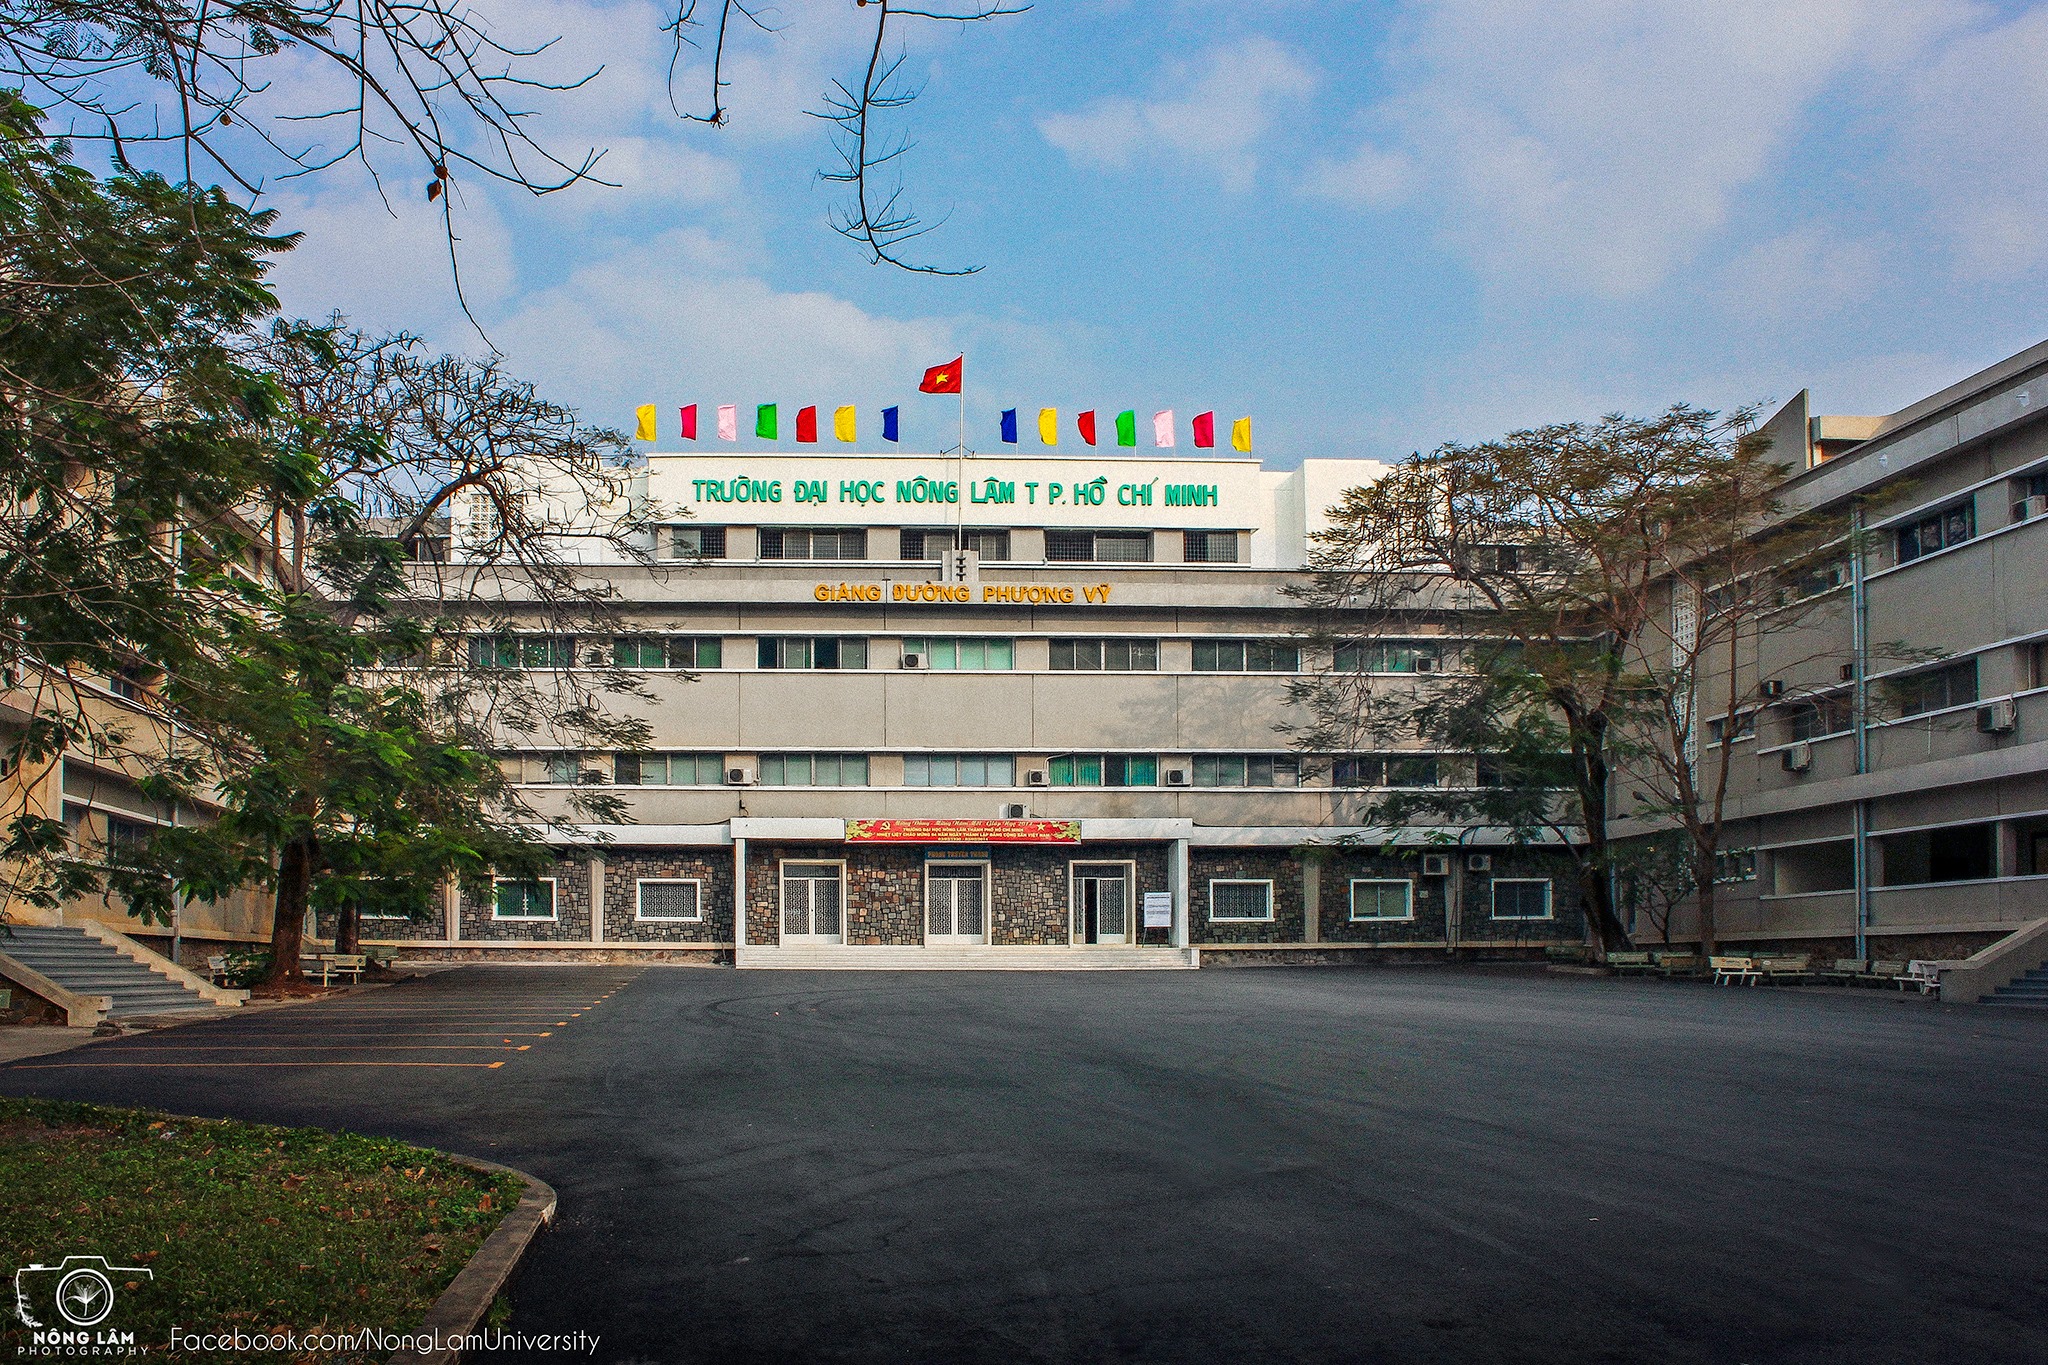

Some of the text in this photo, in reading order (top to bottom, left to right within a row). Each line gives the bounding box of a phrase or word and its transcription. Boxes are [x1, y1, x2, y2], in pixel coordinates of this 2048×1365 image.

[793, 480, 828, 506] ĐẠI
[839, 480, 885, 506] HỌC
[896, 475, 959, 503] NÔNG
[970, 476, 1015, 503] LÂM
[1073, 475, 1108, 505] HỒ
[1117, 477, 1159, 506] CHÍ
[1164, 484, 1218, 506] MINH
[892, 581, 970, 602] ĐƯỜNG
[983, 585, 1075, 606] PHƯỢNG
[1082, 583, 1112, 604] VỸ
